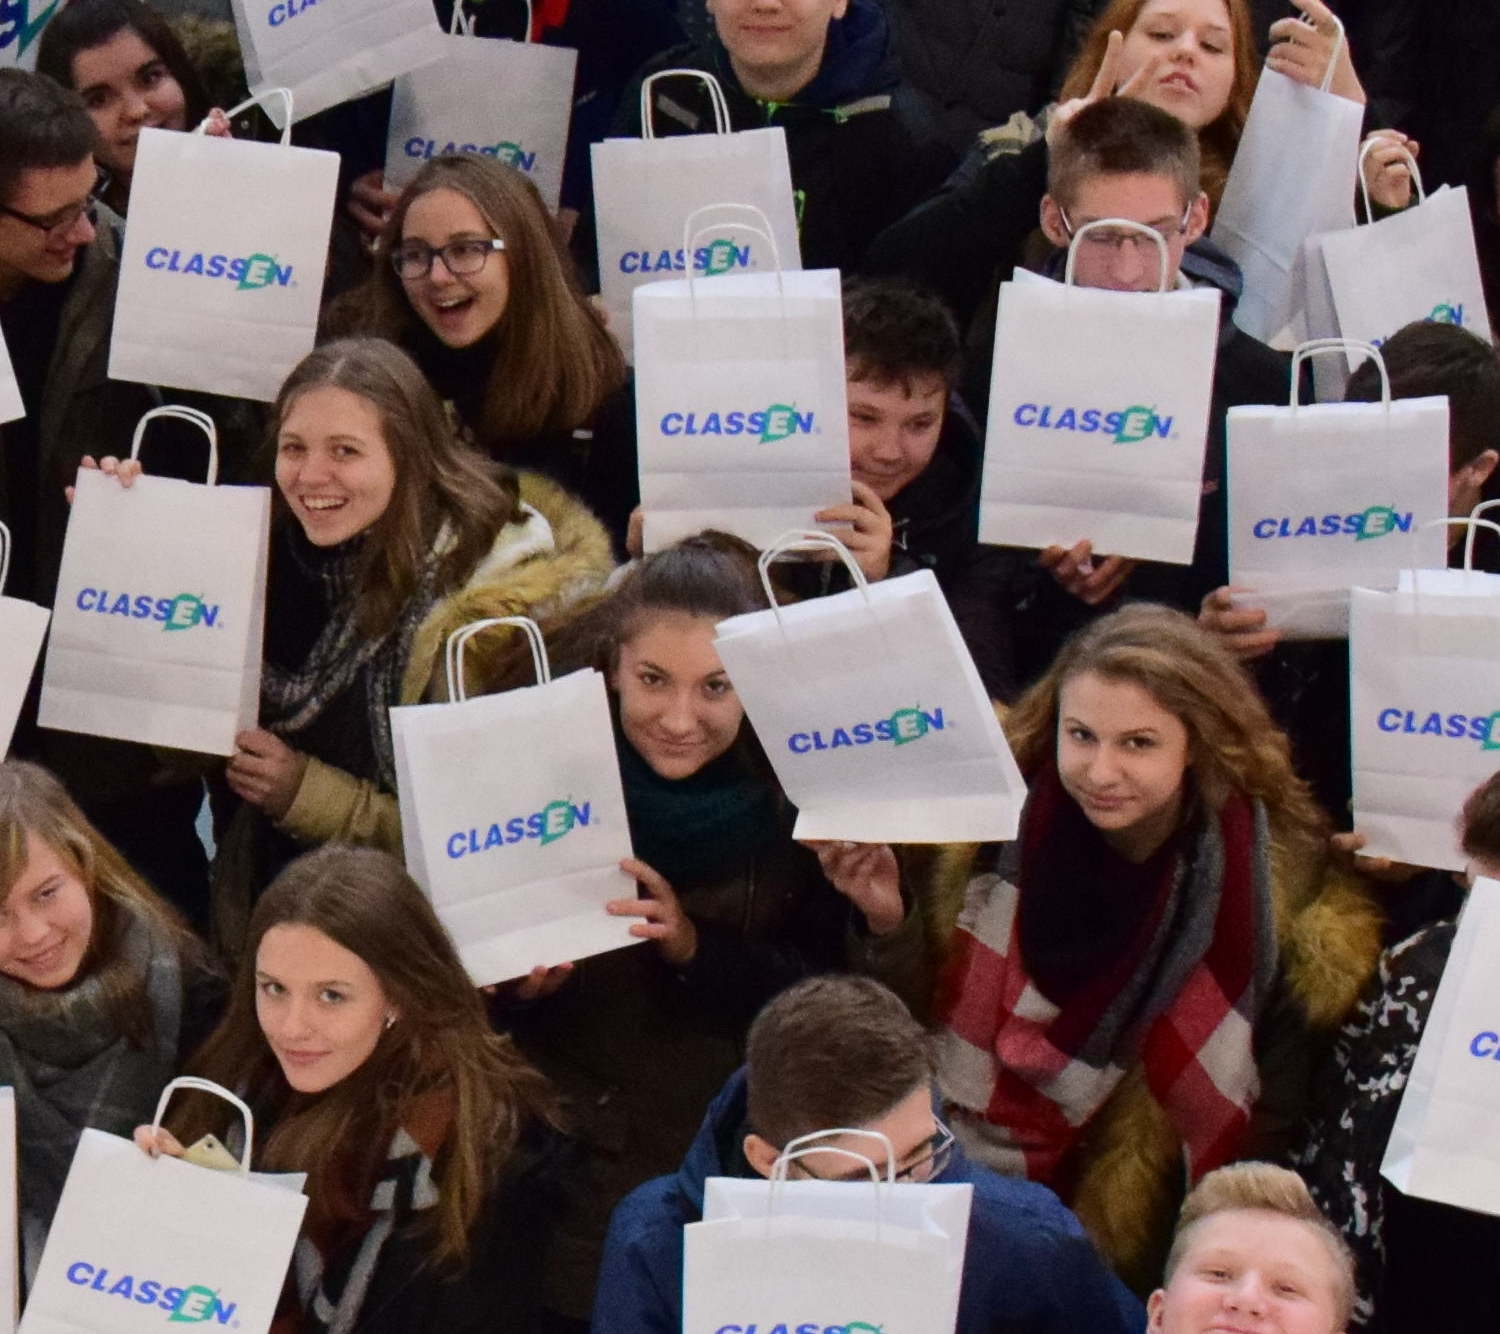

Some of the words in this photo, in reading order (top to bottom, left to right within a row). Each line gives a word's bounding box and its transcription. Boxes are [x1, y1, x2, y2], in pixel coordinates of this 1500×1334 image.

[147, 248, 291, 289] CLASSEN
[618, 240, 749, 275] CLASSEN
[661, 405, 813, 442] CLASSEN
[1014, 405, 1172, 443] CLASSEN
[1253, 507, 1412, 539] CLASSEN
[78, 589, 218, 630] CLASSEN
[788, 709, 944, 753] CLASSEN
[448, 801, 590, 858] CLASSEN
[68, 1262, 235, 1323] CLASSEN
